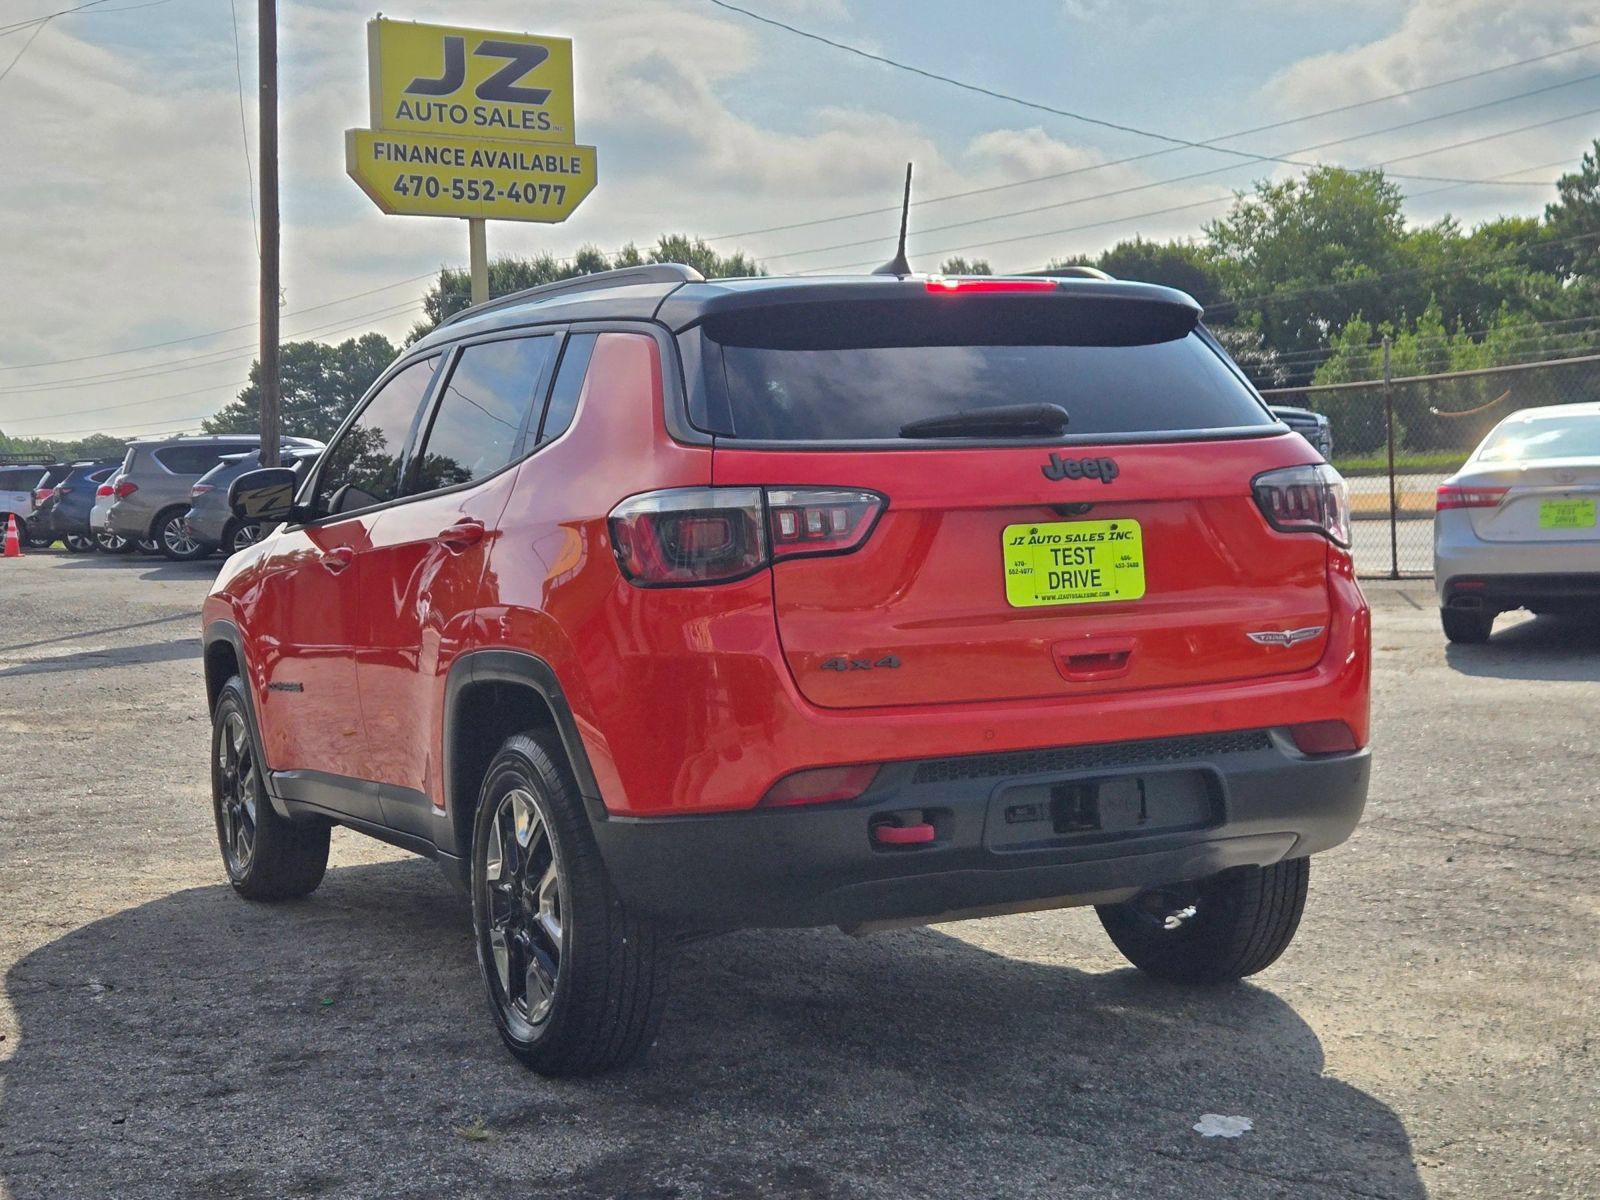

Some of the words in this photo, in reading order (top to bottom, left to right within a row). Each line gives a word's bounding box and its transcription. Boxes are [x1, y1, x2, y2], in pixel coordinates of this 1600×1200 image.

[403, 36, 552, 105] JZ
[395, 100, 468, 124] AUTO
[474, 106, 551, 131] SALES
[373, 142, 465, 167] FINANCE
[470, 150, 581, 174] AVAILABLE
[393, 174, 566, 205] 470-552-4077
[1041, 452, 1119, 484] Jeep
[1009, 536, 1026, 546] JZ
[1028, 534, 1061, 545] AUTO
[1064, 532, 1105, 543] SALES
[1050, 546, 1095, 566] TEST
[1048, 569, 1102, 590] DRIVE
